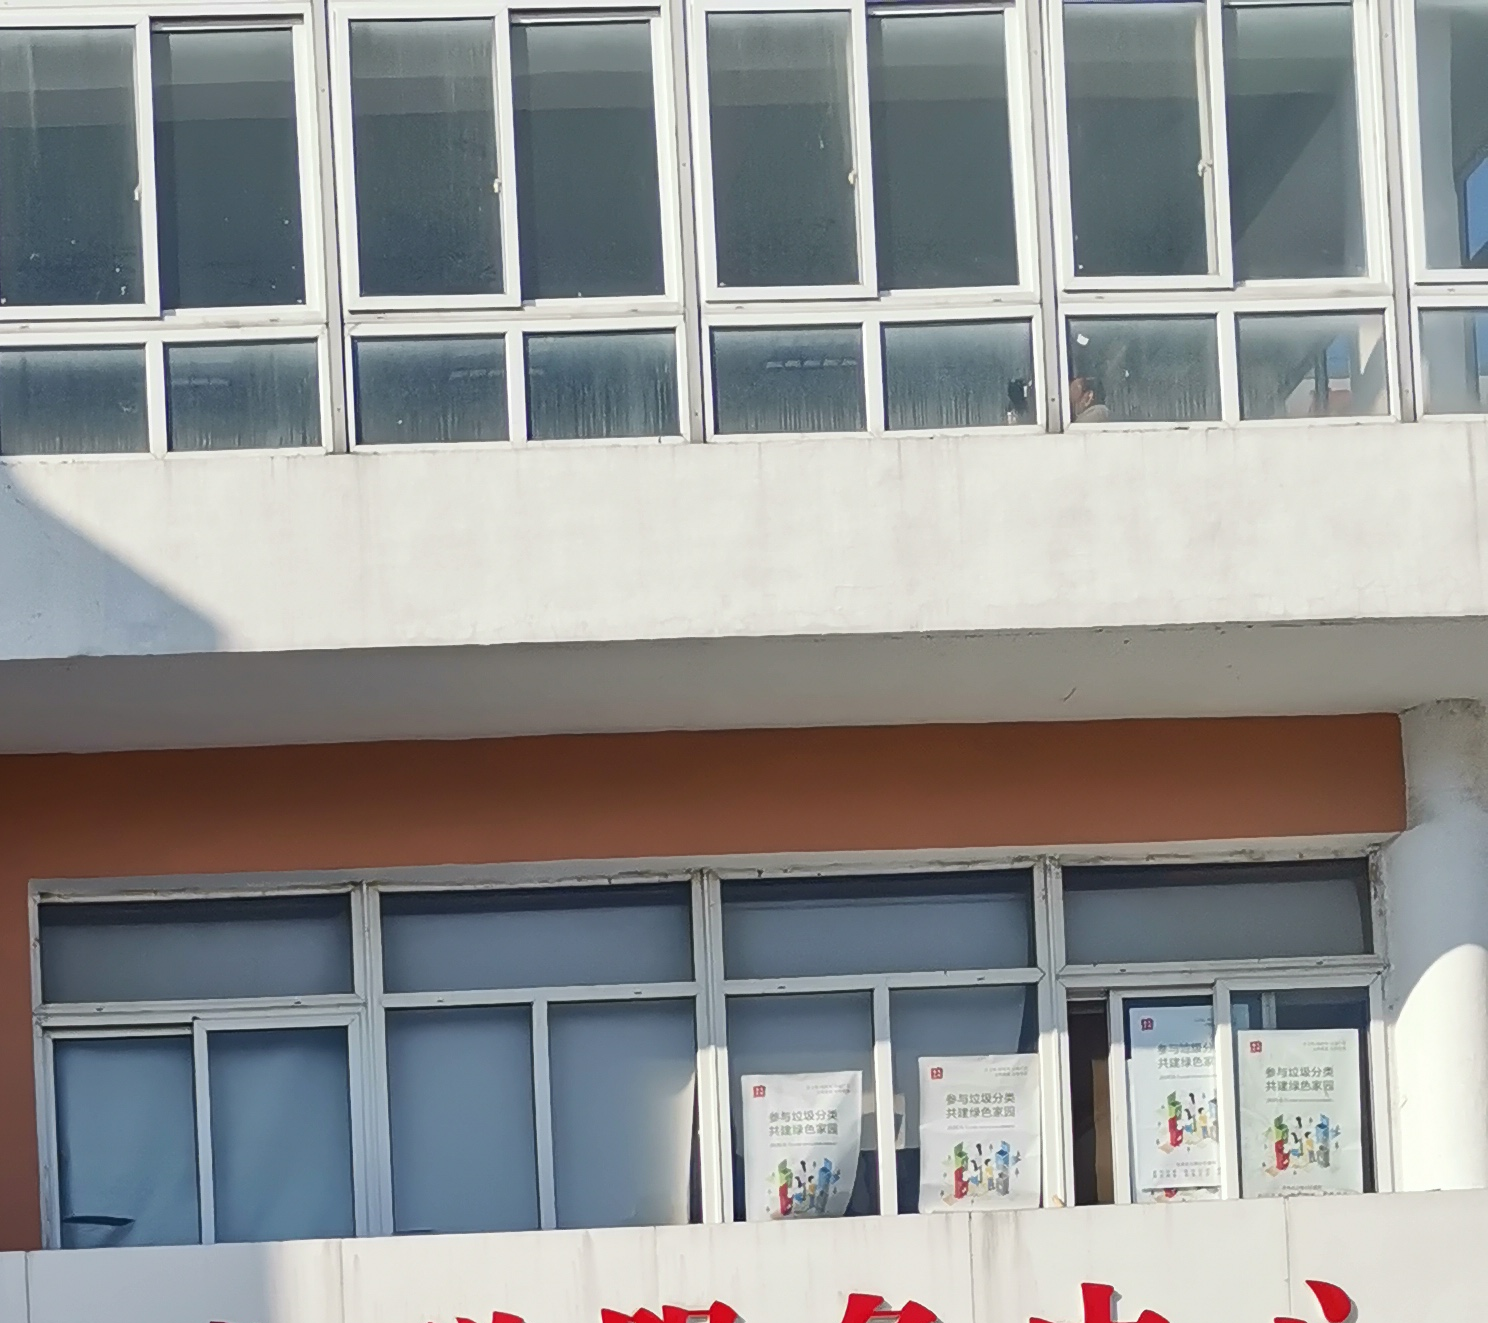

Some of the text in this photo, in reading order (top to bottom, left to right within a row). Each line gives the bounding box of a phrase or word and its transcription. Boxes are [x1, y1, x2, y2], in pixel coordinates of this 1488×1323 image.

[1157, 1042, 1215, 1055] 参与垃圾分
[1157, 1056, 1216, 1069] 共建绿色家
[1265, 1066, 1335, 1079] 参与垃圾分类
[1265, 1079, 1335, 1093] 共建绿色家园
[945, 1092, 1016, 1106] 参与垃圾分类
[769, 1109, 839, 1123] 参与垃圾分类
[945, 1106, 1016, 1119] 共建绿色家园
[769, 1123, 839, 1137] 共建绿色家园
